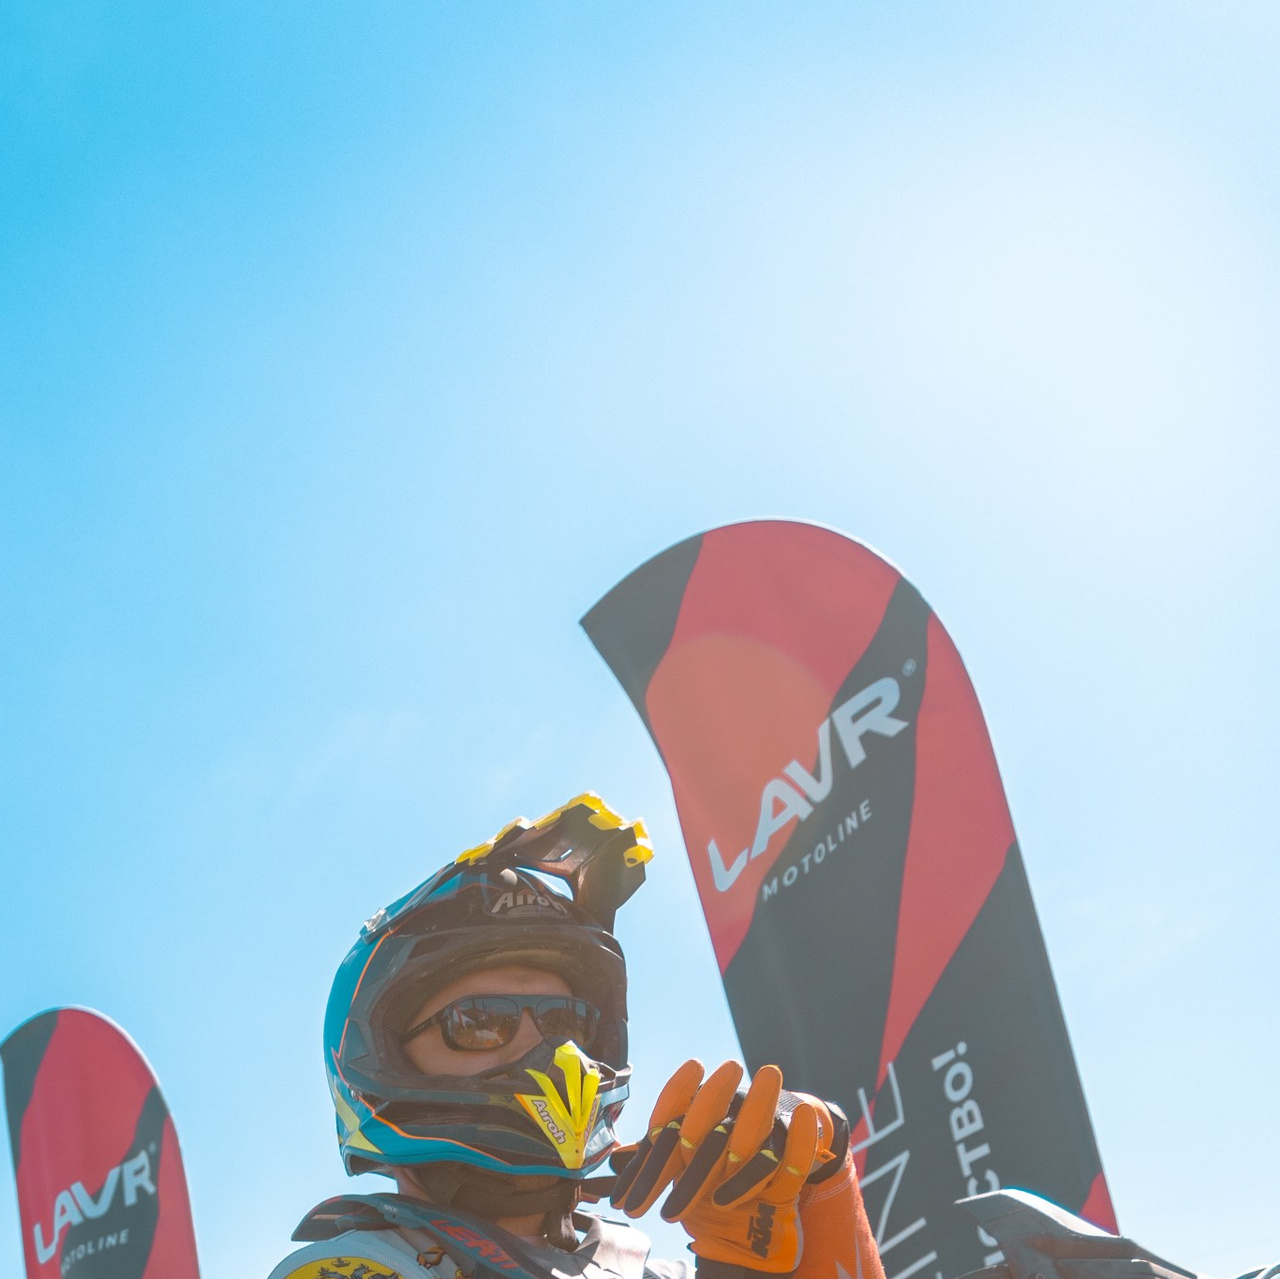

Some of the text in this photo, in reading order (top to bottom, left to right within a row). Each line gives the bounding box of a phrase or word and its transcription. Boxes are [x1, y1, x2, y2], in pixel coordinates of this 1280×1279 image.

[707, 676, 910, 893] LAVR
[761, 800, 873, 901] MOTOLINE
[532, 1099, 566, 1145] Airoh
[34, 1149, 157, 1265] LAVR
